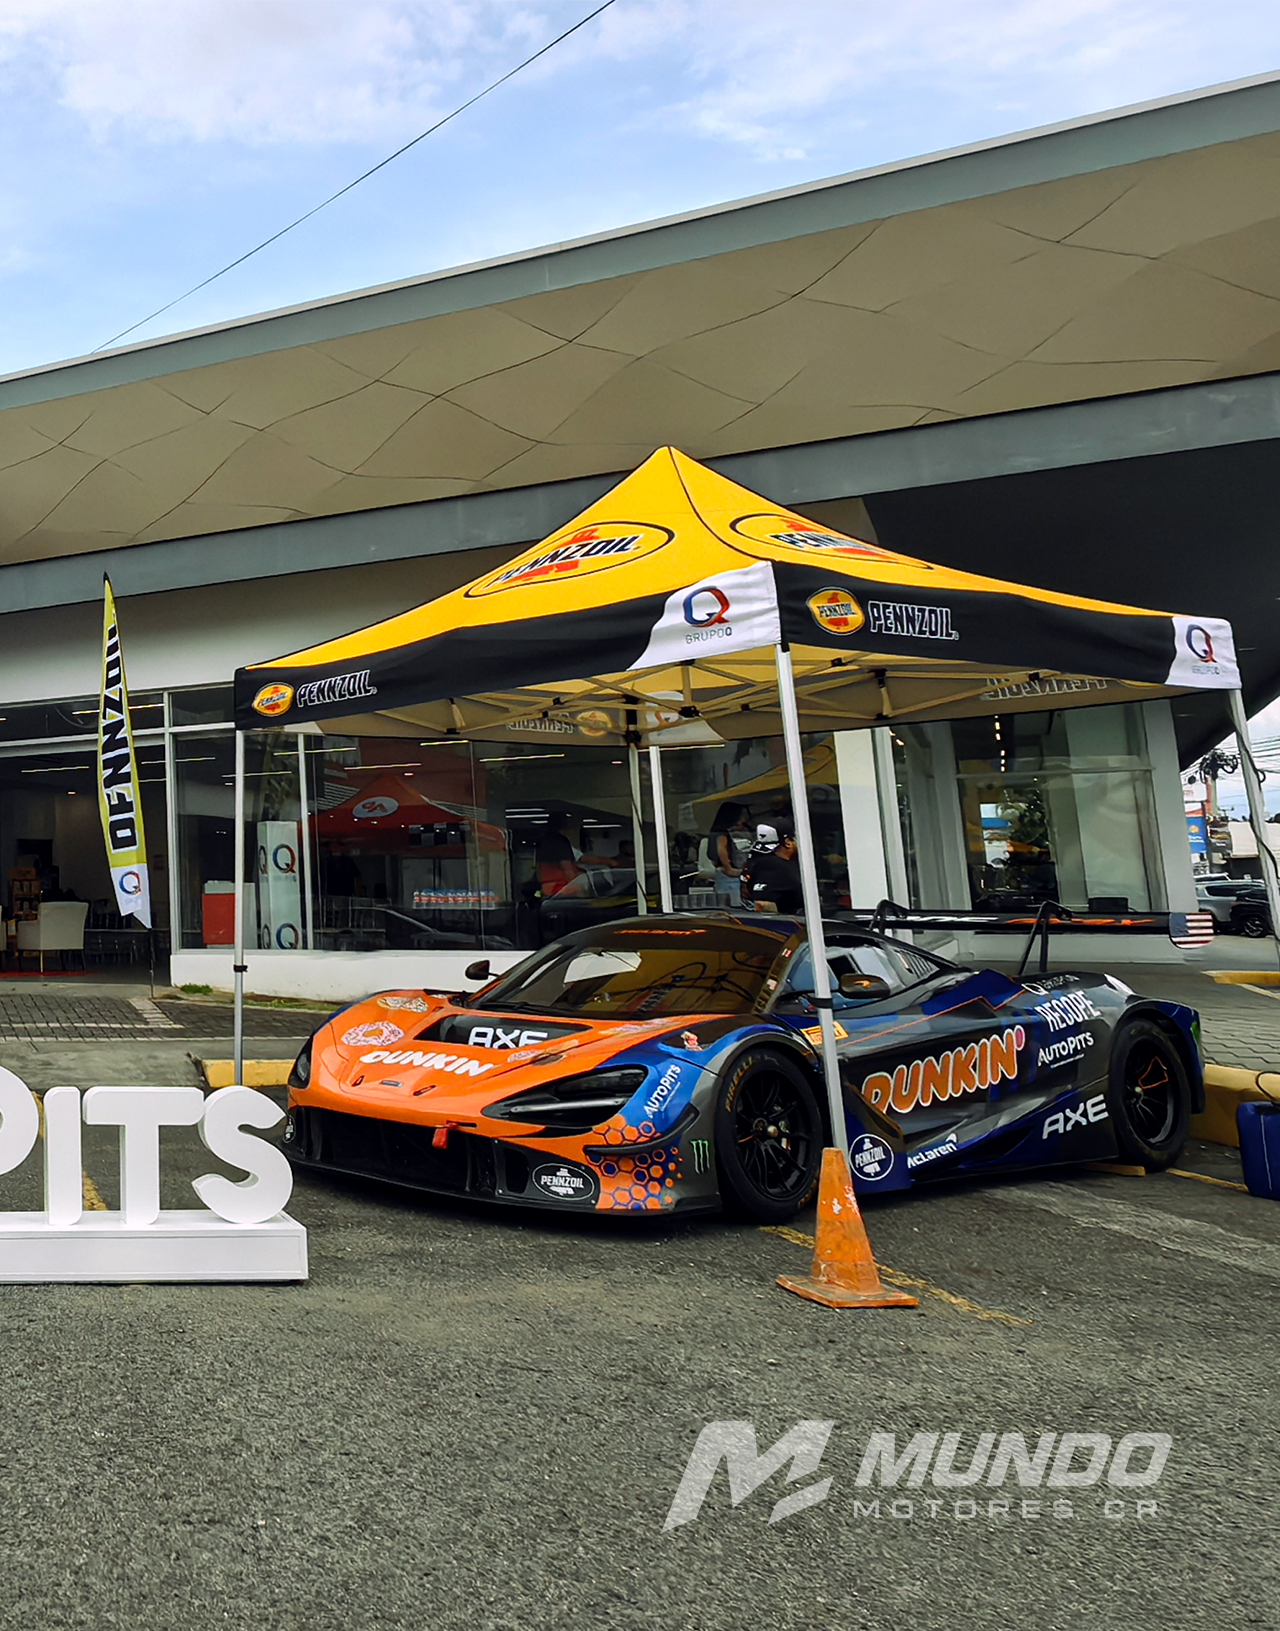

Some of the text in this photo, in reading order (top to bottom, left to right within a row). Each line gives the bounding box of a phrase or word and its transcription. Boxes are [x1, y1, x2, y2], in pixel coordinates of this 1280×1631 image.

[869, 601, 958, 640] PENNZOIL
[297, 670, 372, 708] PENNZOIL
[1034, 990, 1101, 1032] RECOPE
[467, 1026, 549, 1049] AXE
[1042, 1094, 1109, 1140] AXE
[541, 1175, 584, 1189] PENNZOIL
